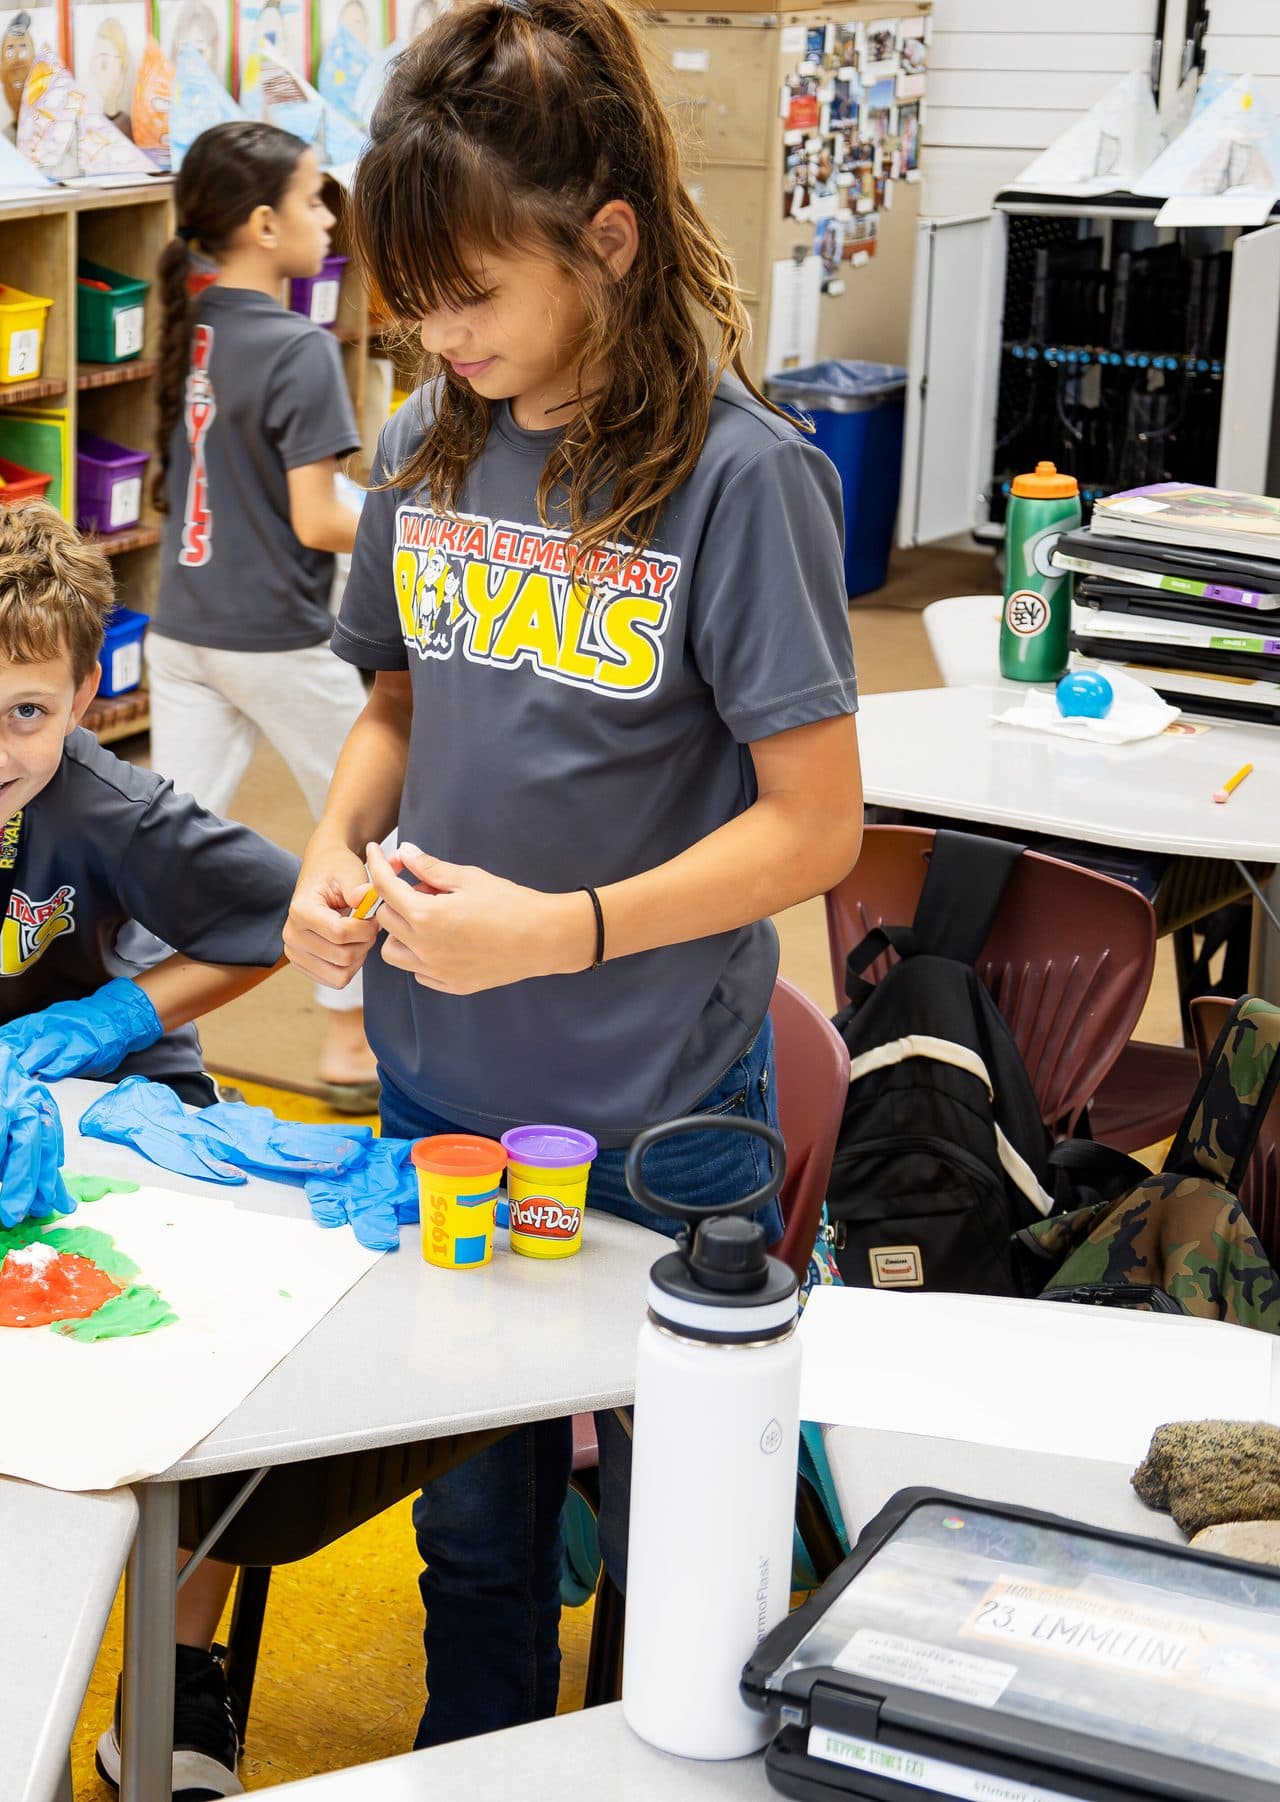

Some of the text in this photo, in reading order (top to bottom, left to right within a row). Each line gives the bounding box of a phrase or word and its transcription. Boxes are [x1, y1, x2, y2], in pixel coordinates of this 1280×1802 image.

[18, 351, 28, 372] 2
[491, 532, 676, 595] ELEMENTARY
[430, 1193, 449, 1257] 1965
[509, 1202, 581, 1233] Play-Doh
[756, 1558, 769, 1643] ermoFlask
